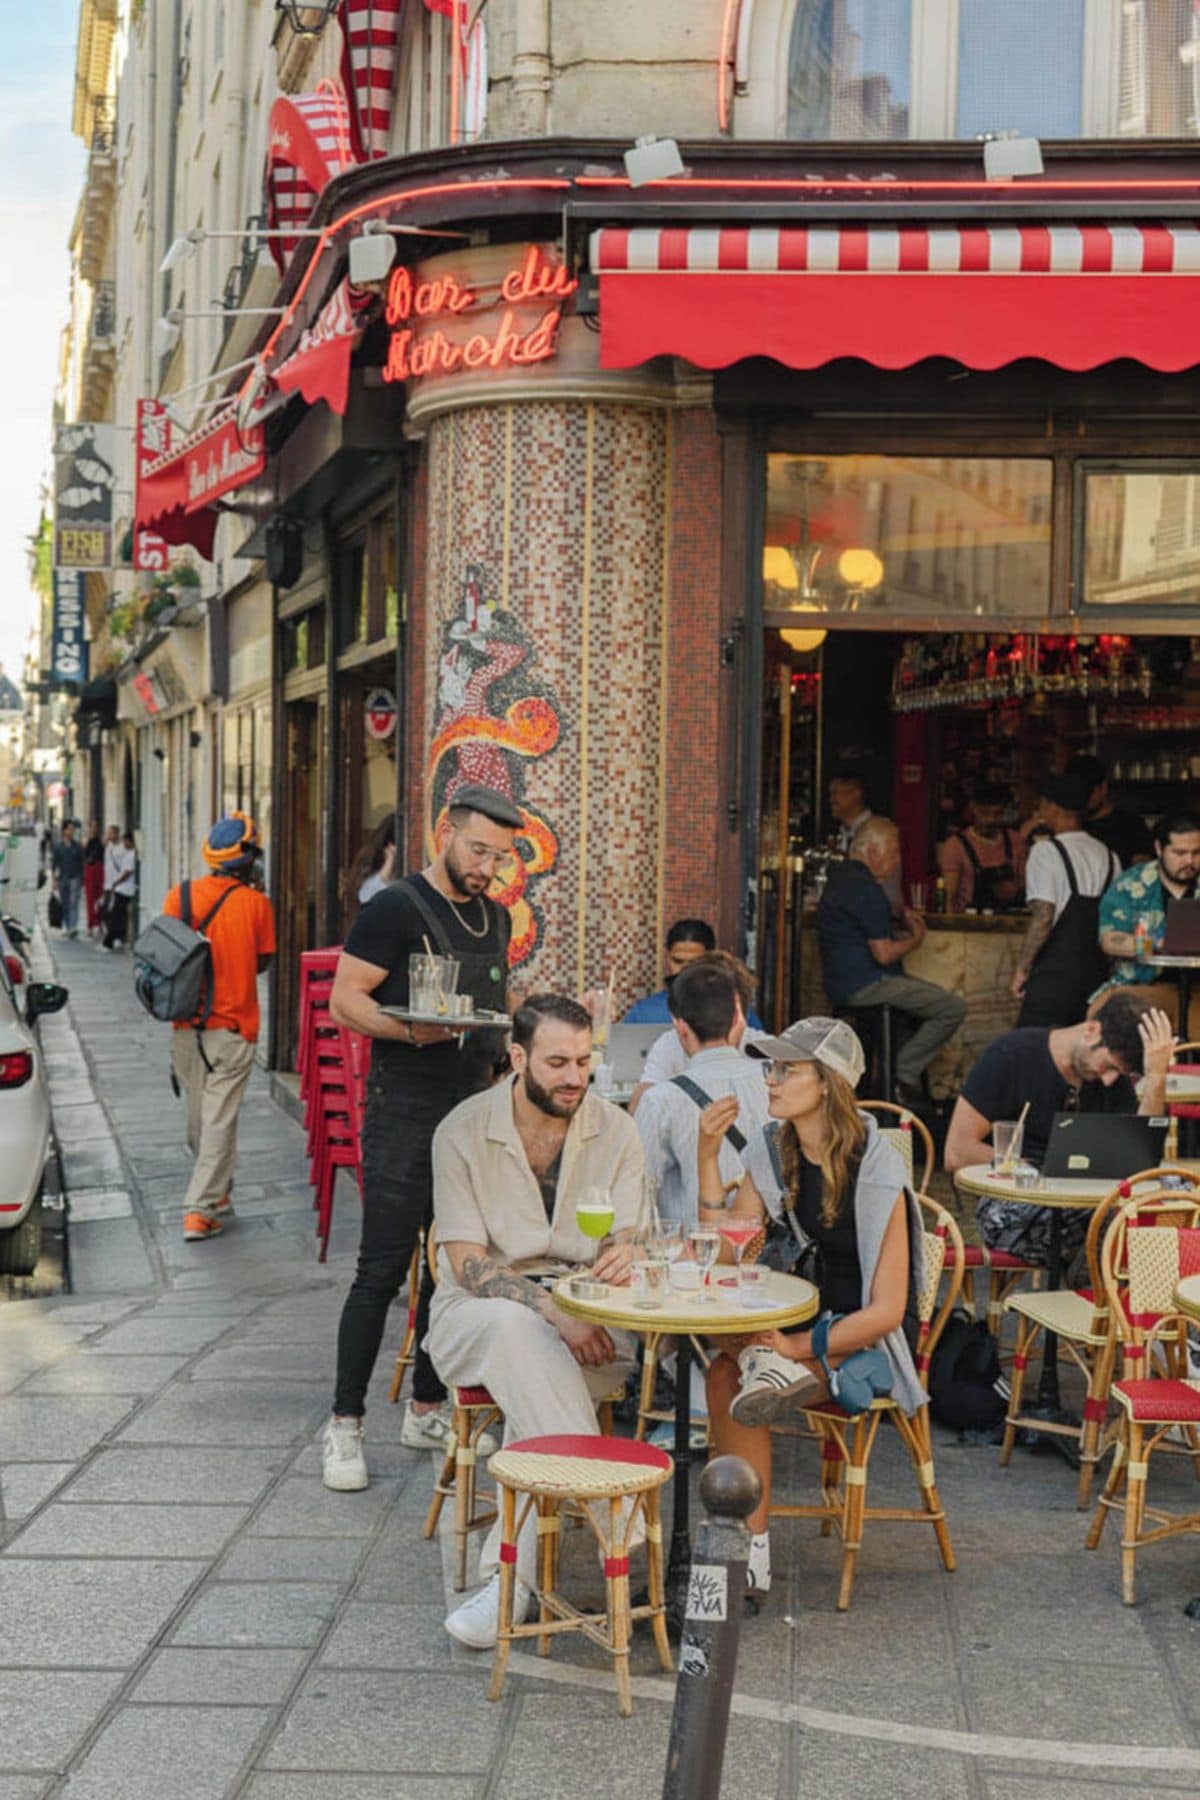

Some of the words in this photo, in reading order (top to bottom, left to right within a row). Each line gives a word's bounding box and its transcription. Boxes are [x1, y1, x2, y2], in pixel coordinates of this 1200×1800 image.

[386, 266, 475, 325] Bar
[503, 244, 578, 301] du
[382, 308, 560, 383] Marché
[62, 530, 104, 549] FISH
